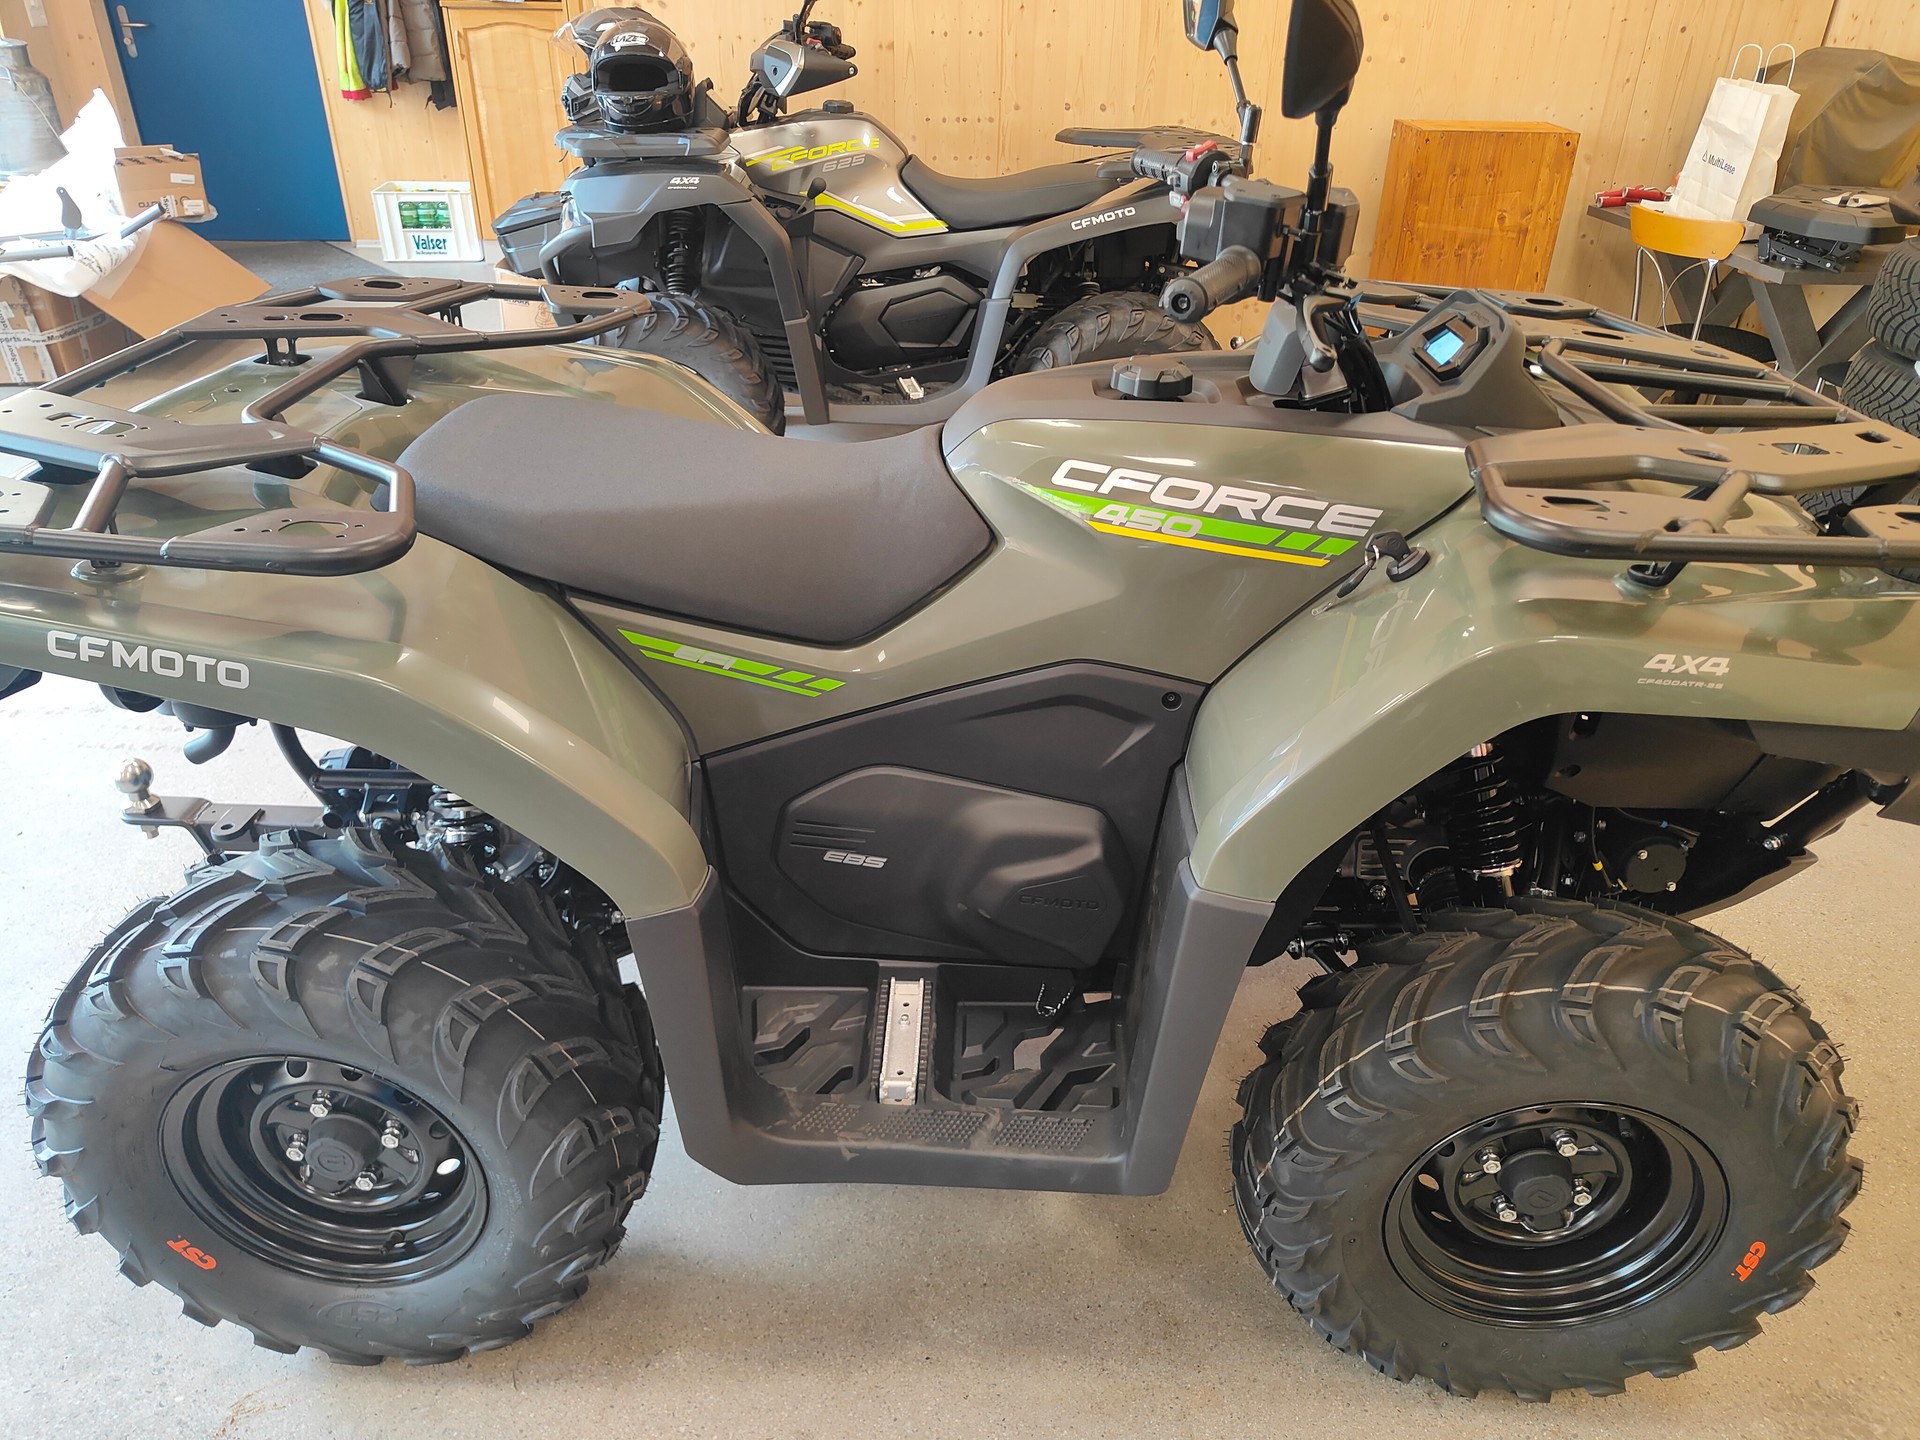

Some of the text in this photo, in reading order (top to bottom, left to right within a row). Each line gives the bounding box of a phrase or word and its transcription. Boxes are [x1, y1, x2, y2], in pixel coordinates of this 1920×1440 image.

[771, 137, 880, 171] CFORCE
[822, 153, 866, 173] 625
[669, 176, 700, 185] 4X4
[1071, 206, 1136, 231] CFMOTO
[412, 234, 447, 250] Valser
[1051, 459, 1384, 537] CFORCE
[1093, 504, 1203, 538] 450
[47, 630, 250, 690] CFMOTO
[673, 645, 737, 670] EFI
[1643, 653, 1730, 676] 4X4
[823, 851, 888, 869] EBS
[1020, 895, 1100, 911] CFMOTO
[166, 1238, 218, 1271] CST
[1735, 1241, 1766, 1282] CST
